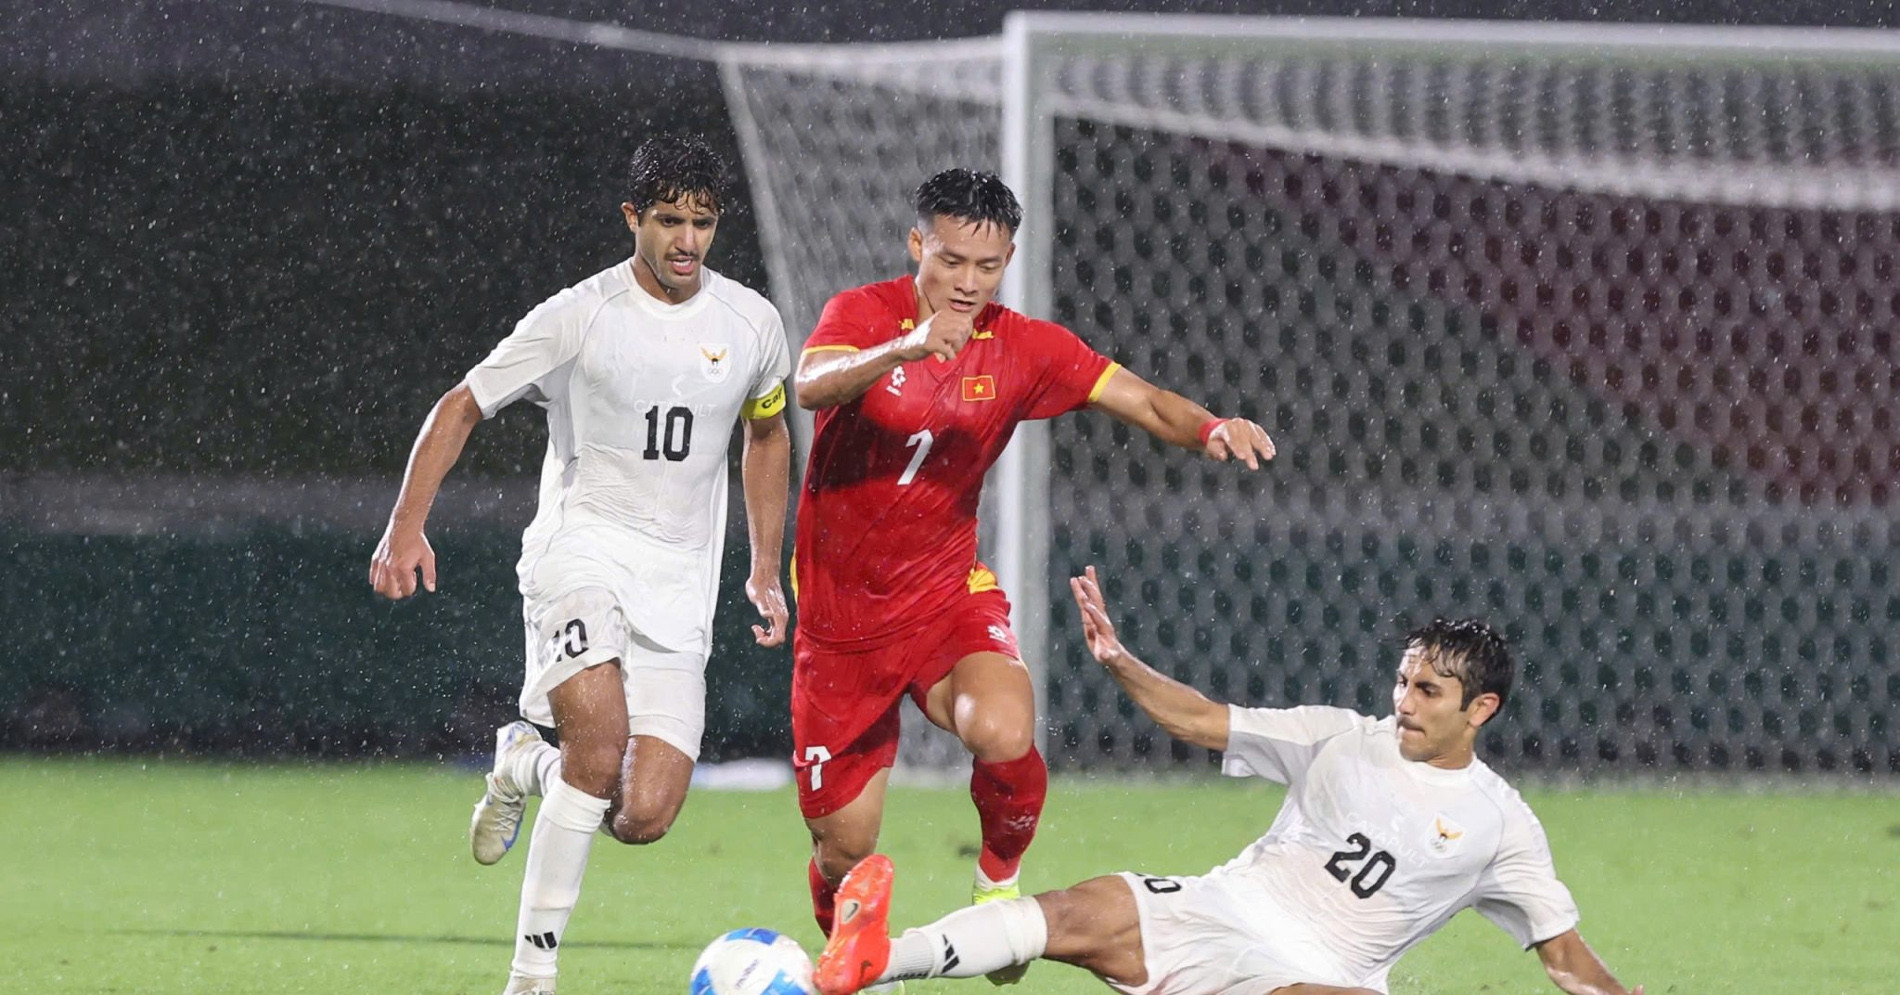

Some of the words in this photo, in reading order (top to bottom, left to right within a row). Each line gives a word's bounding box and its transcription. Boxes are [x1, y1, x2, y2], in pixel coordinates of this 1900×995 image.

[643, 405, 694, 461] 10
[897, 429, 933, 485] 7
[804, 746, 832, 791] 7
[1136, 873, 1182, 894] 0
[1323, 832, 1396, 899] 20
